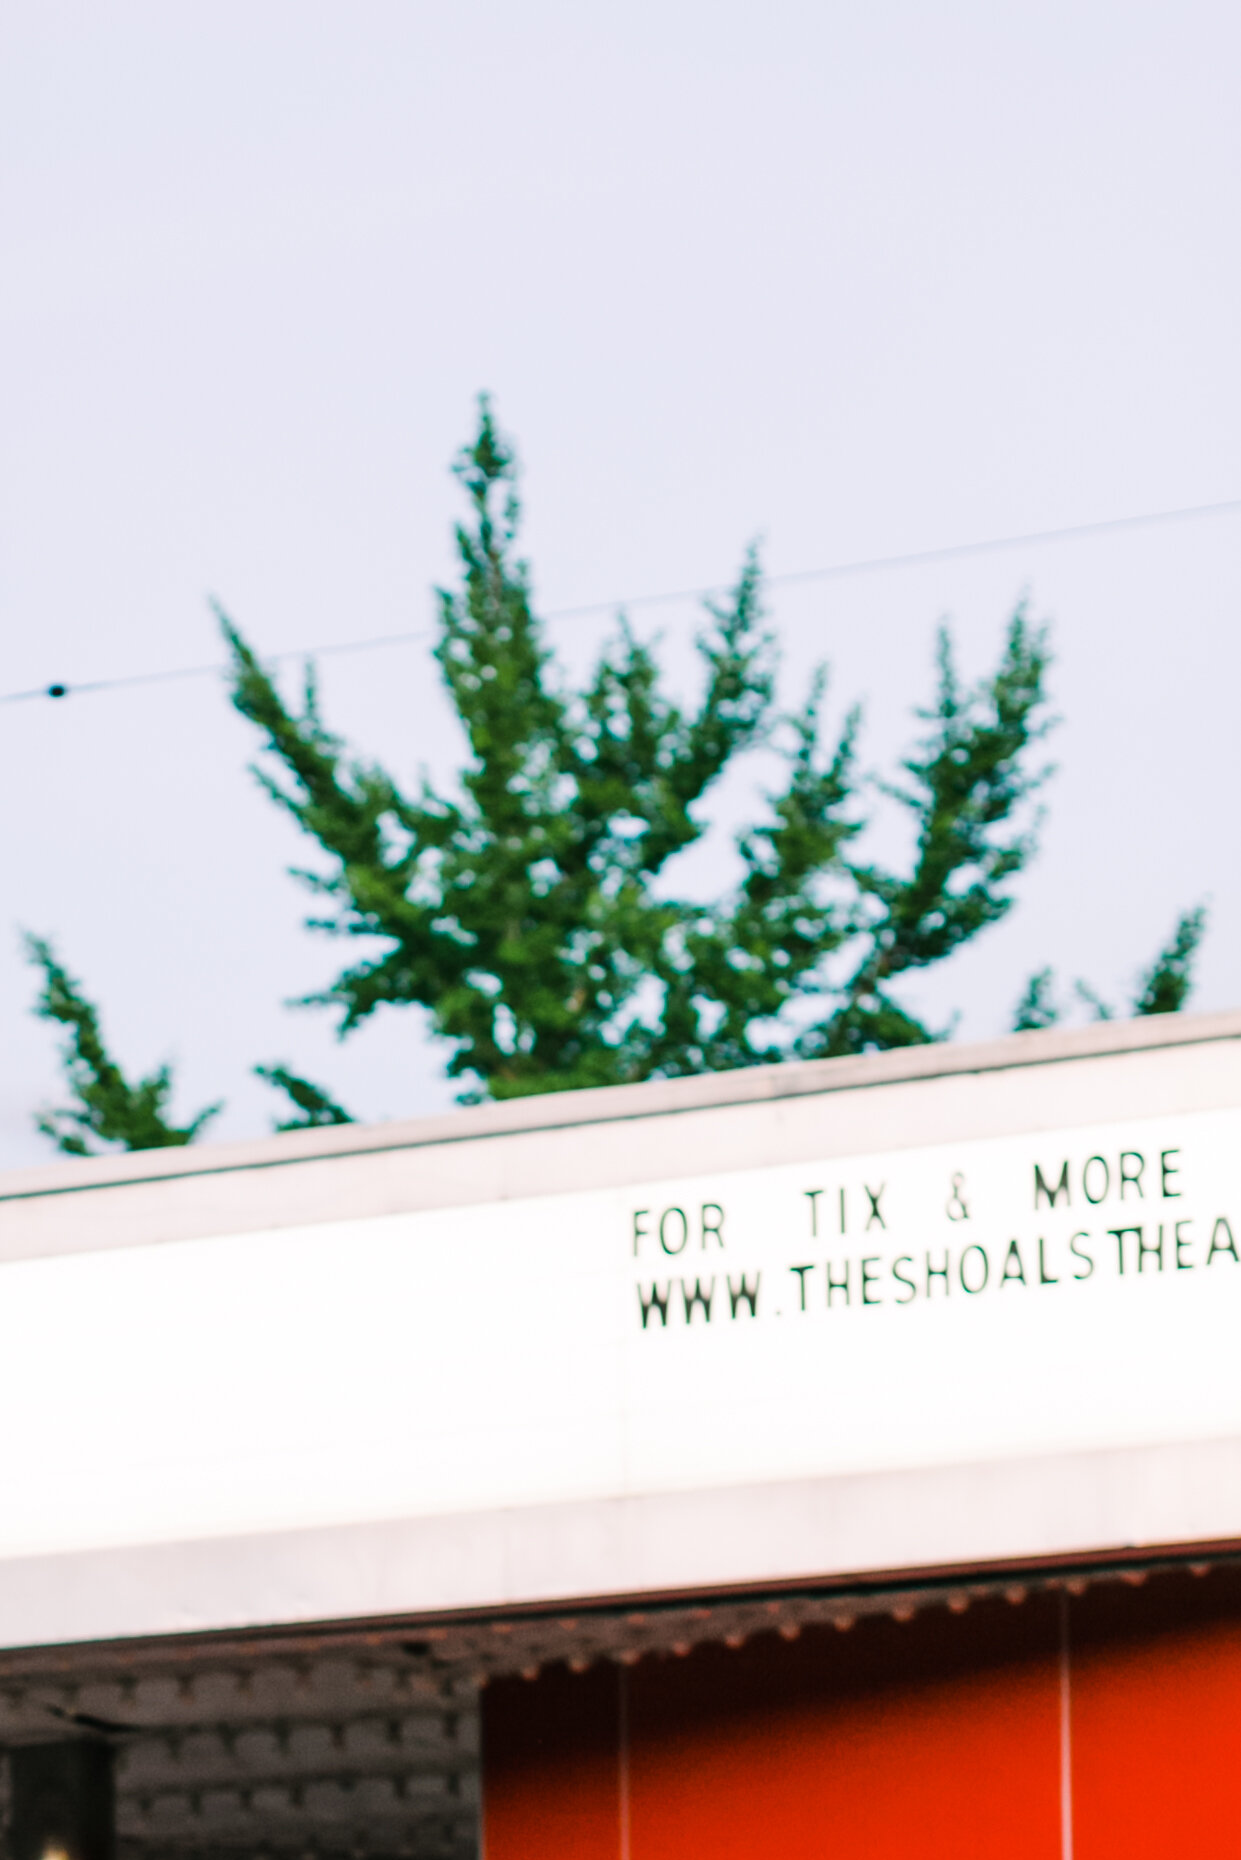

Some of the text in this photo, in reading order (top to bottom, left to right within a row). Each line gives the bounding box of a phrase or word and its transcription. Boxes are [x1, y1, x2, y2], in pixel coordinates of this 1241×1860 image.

[632, 1148, 1183, 1258] FOR TIX & MORE
